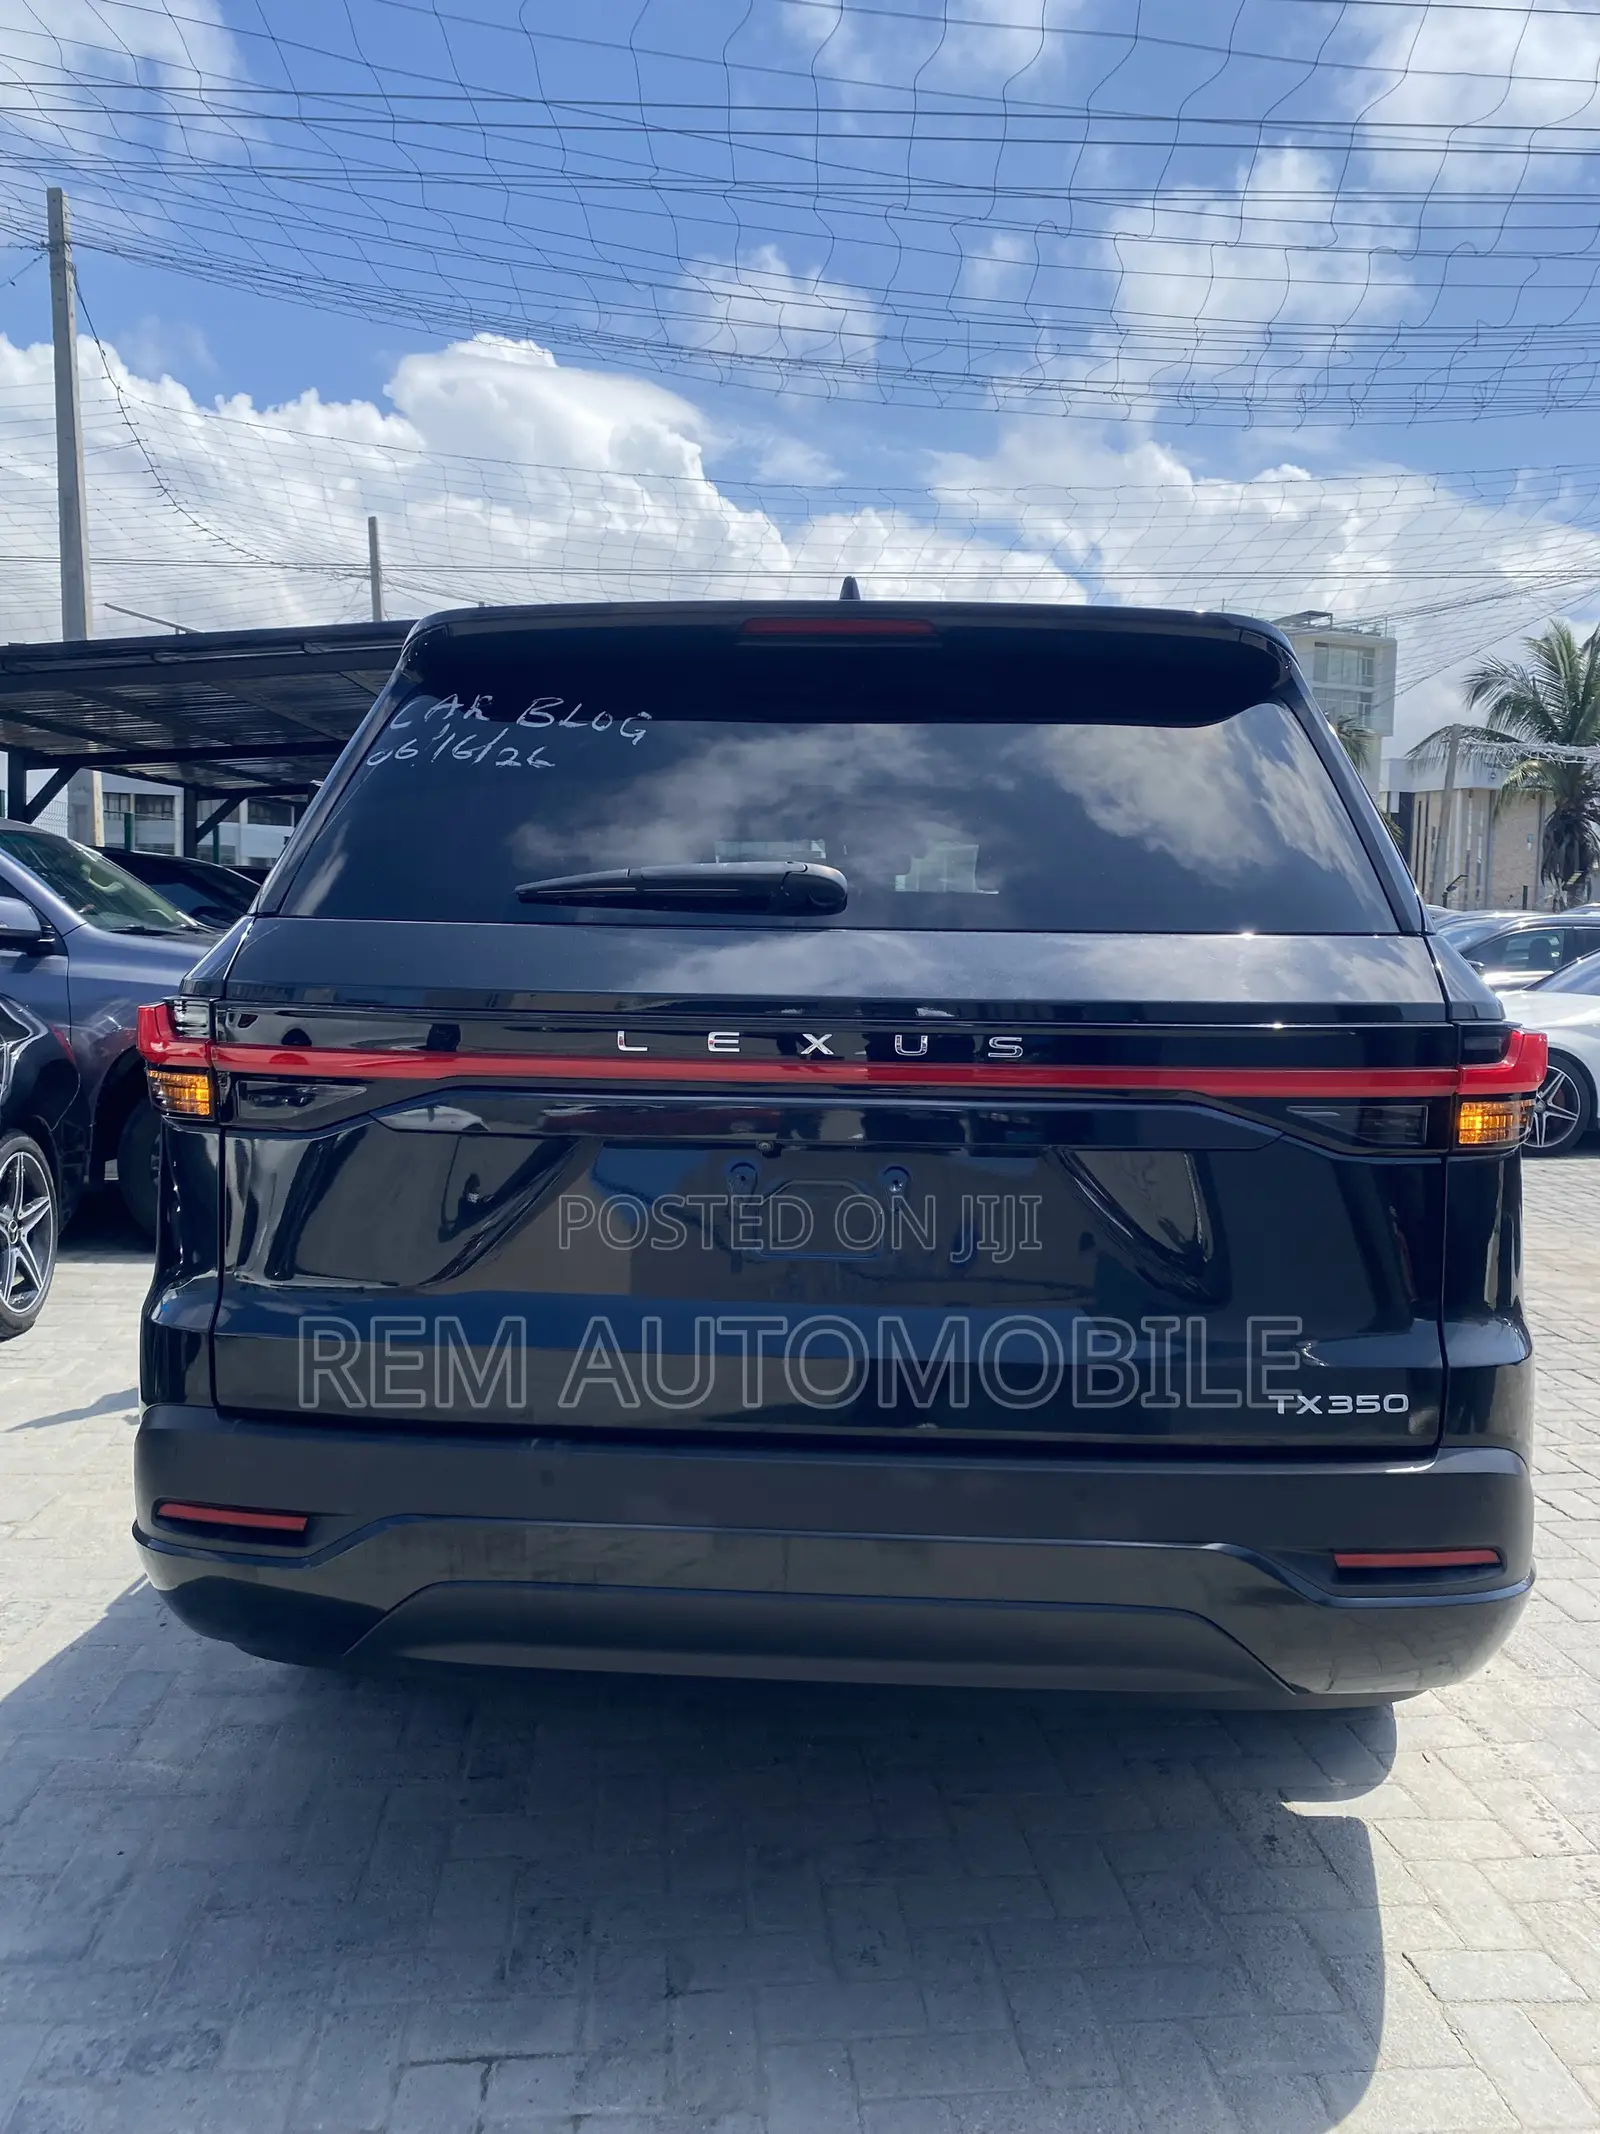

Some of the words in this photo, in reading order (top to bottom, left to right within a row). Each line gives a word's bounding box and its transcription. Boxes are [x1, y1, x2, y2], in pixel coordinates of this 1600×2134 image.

[390, 693, 494, 730] CAR
[516, 697, 652, 745] BLOG
[617, 1030, 1024, 1058] LEXUS
[1268, 1393, 1409, 1414] TX350
